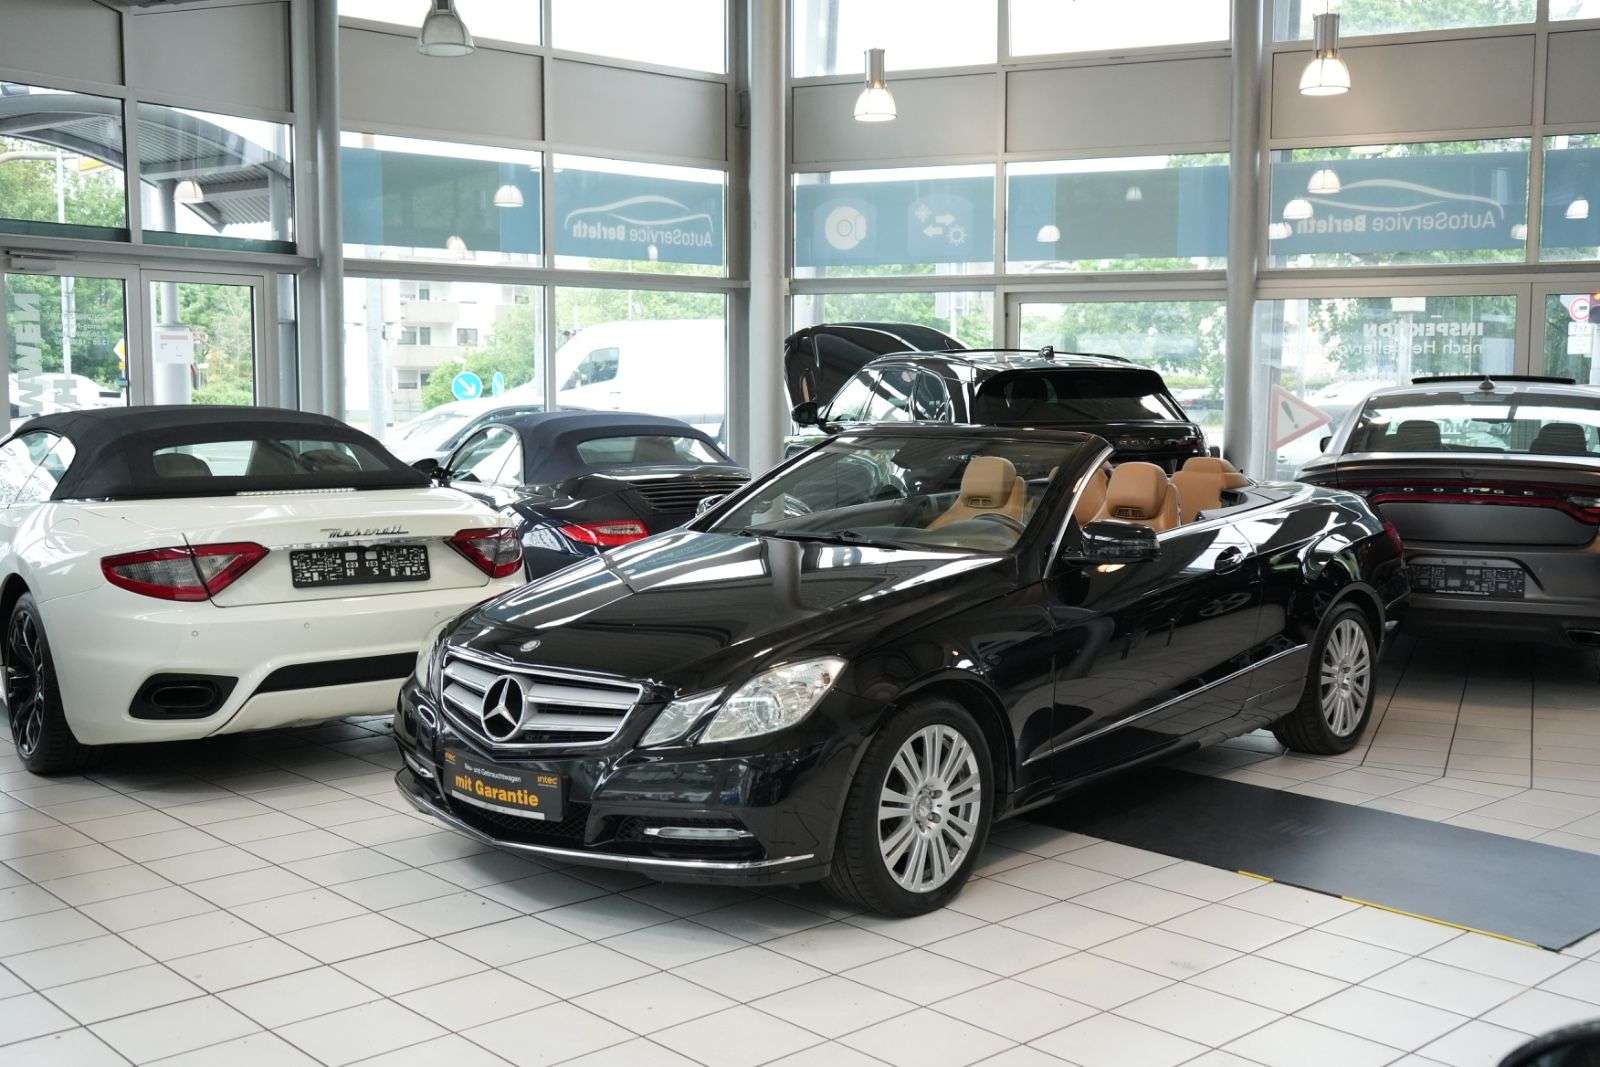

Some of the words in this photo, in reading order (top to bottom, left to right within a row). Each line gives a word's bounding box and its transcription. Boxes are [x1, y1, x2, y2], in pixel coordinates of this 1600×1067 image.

[455, 775, 472, 792] mit
[475, 780, 539, 807] Garantie
[537, 775, 559, 786] intec
